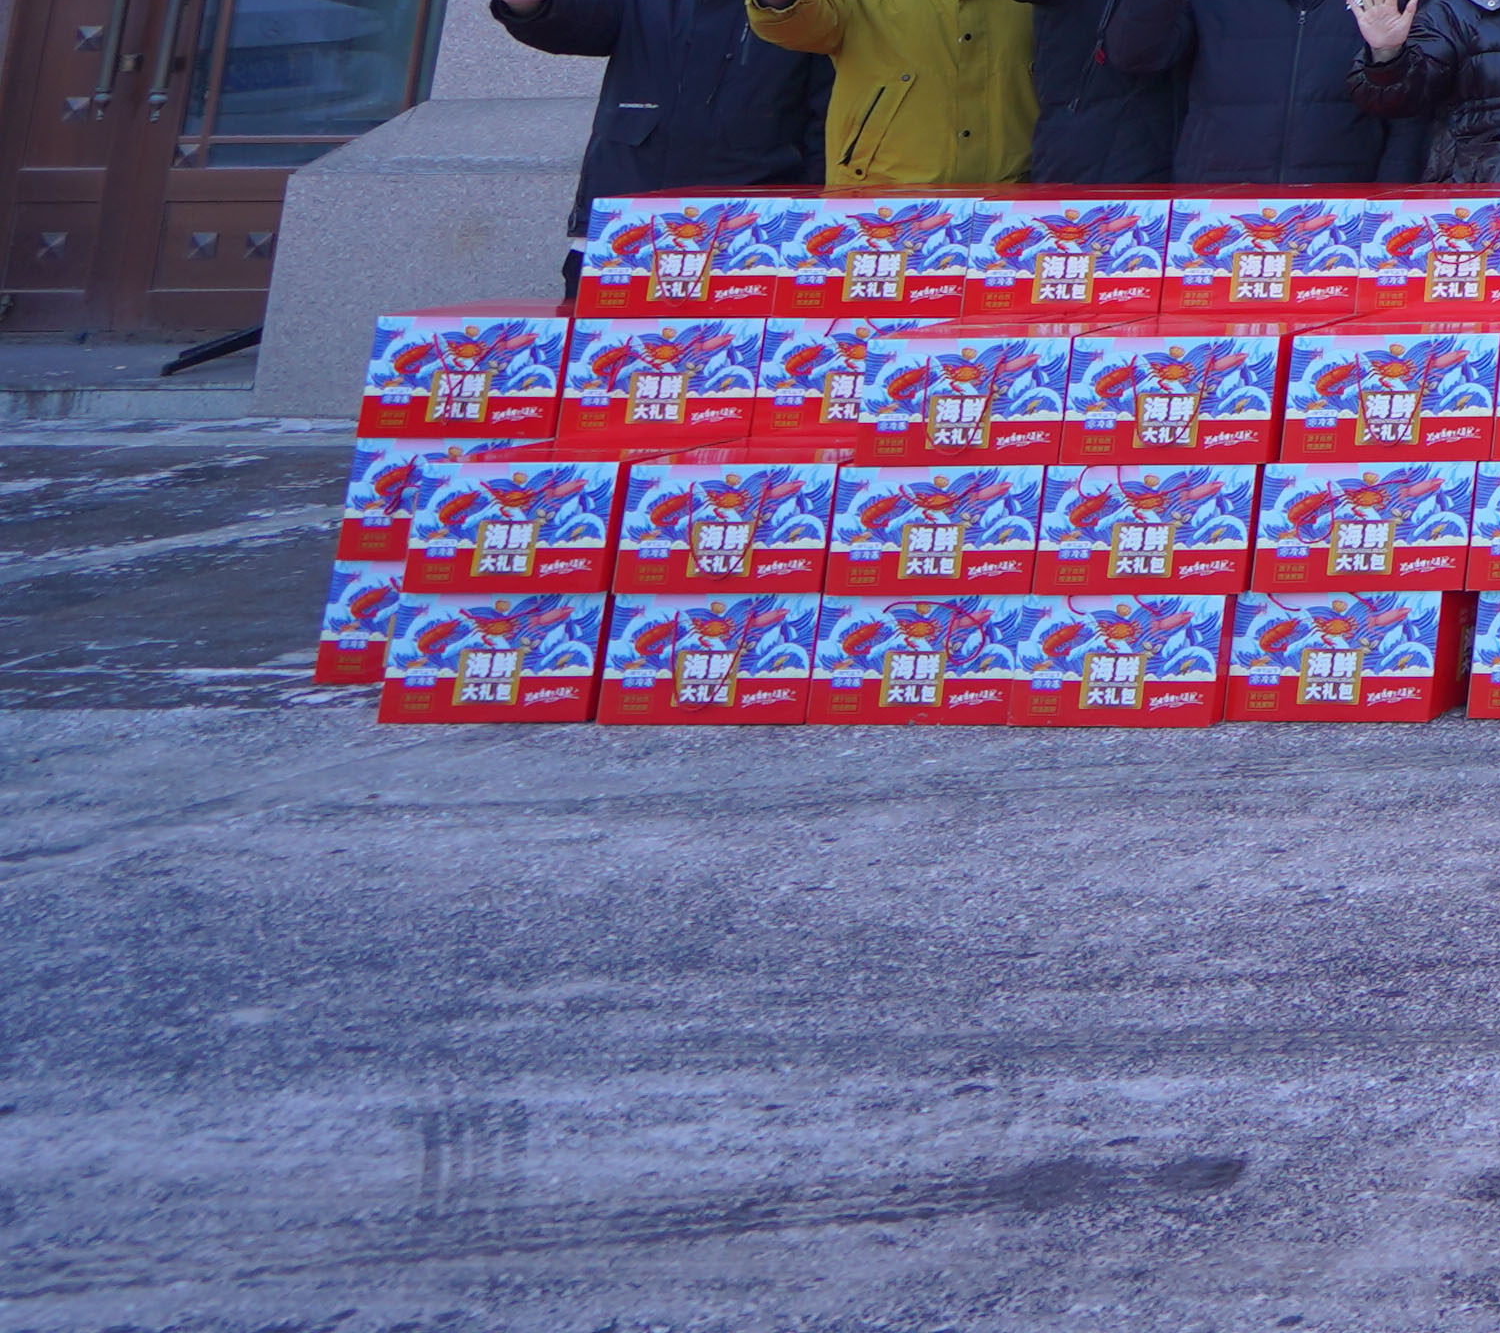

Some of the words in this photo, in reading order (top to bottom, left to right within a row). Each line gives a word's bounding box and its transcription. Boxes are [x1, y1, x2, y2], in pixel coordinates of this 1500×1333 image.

[851, 254, 901, 276] 海鲜
[1040, 256, 1090, 278] 海鲜
[1238, 255, 1286, 277] 海鲜
[1432, 254, 1482, 276] 海鲜
[850, 282, 897, 297] 大礼包
[1039, 284, 1086, 299] 大礼包
[1237, 283, 1283, 298] 大礼包
[1431, 282, 1478, 297] 大礼包
[635, 376, 684, 398] 海鲜
[632, 404, 679, 419] 大礼包
[482, 524, 534, 549] 海鲜
[908, 527, 958, 552] 海鲜
[1118, 526, 1169, 551] 海鲜
[1338, 524, 1388, 548] 海鲜
[478, 555, 528, 572] 大礼包
[907, 557, 954, 574] 大礼包
[1116, 556, 1166, 573] 大礼包
[1336, 553, 1385, 570] 大礼包
[465, 652, 518, 678] 海鲜
[889, 654, 941, 679] 海鲜
[1089, 656, 1141, 682] 海鲜
[1307, 652, 1357, 677] 海鲜
[461, 683, 512, 701] 大礼包
[886, 685, 937, 702] 大礼包
[1086, 687, 1137, 705] 大礼包
[1306, 683, 1353, 700] 大礼包
